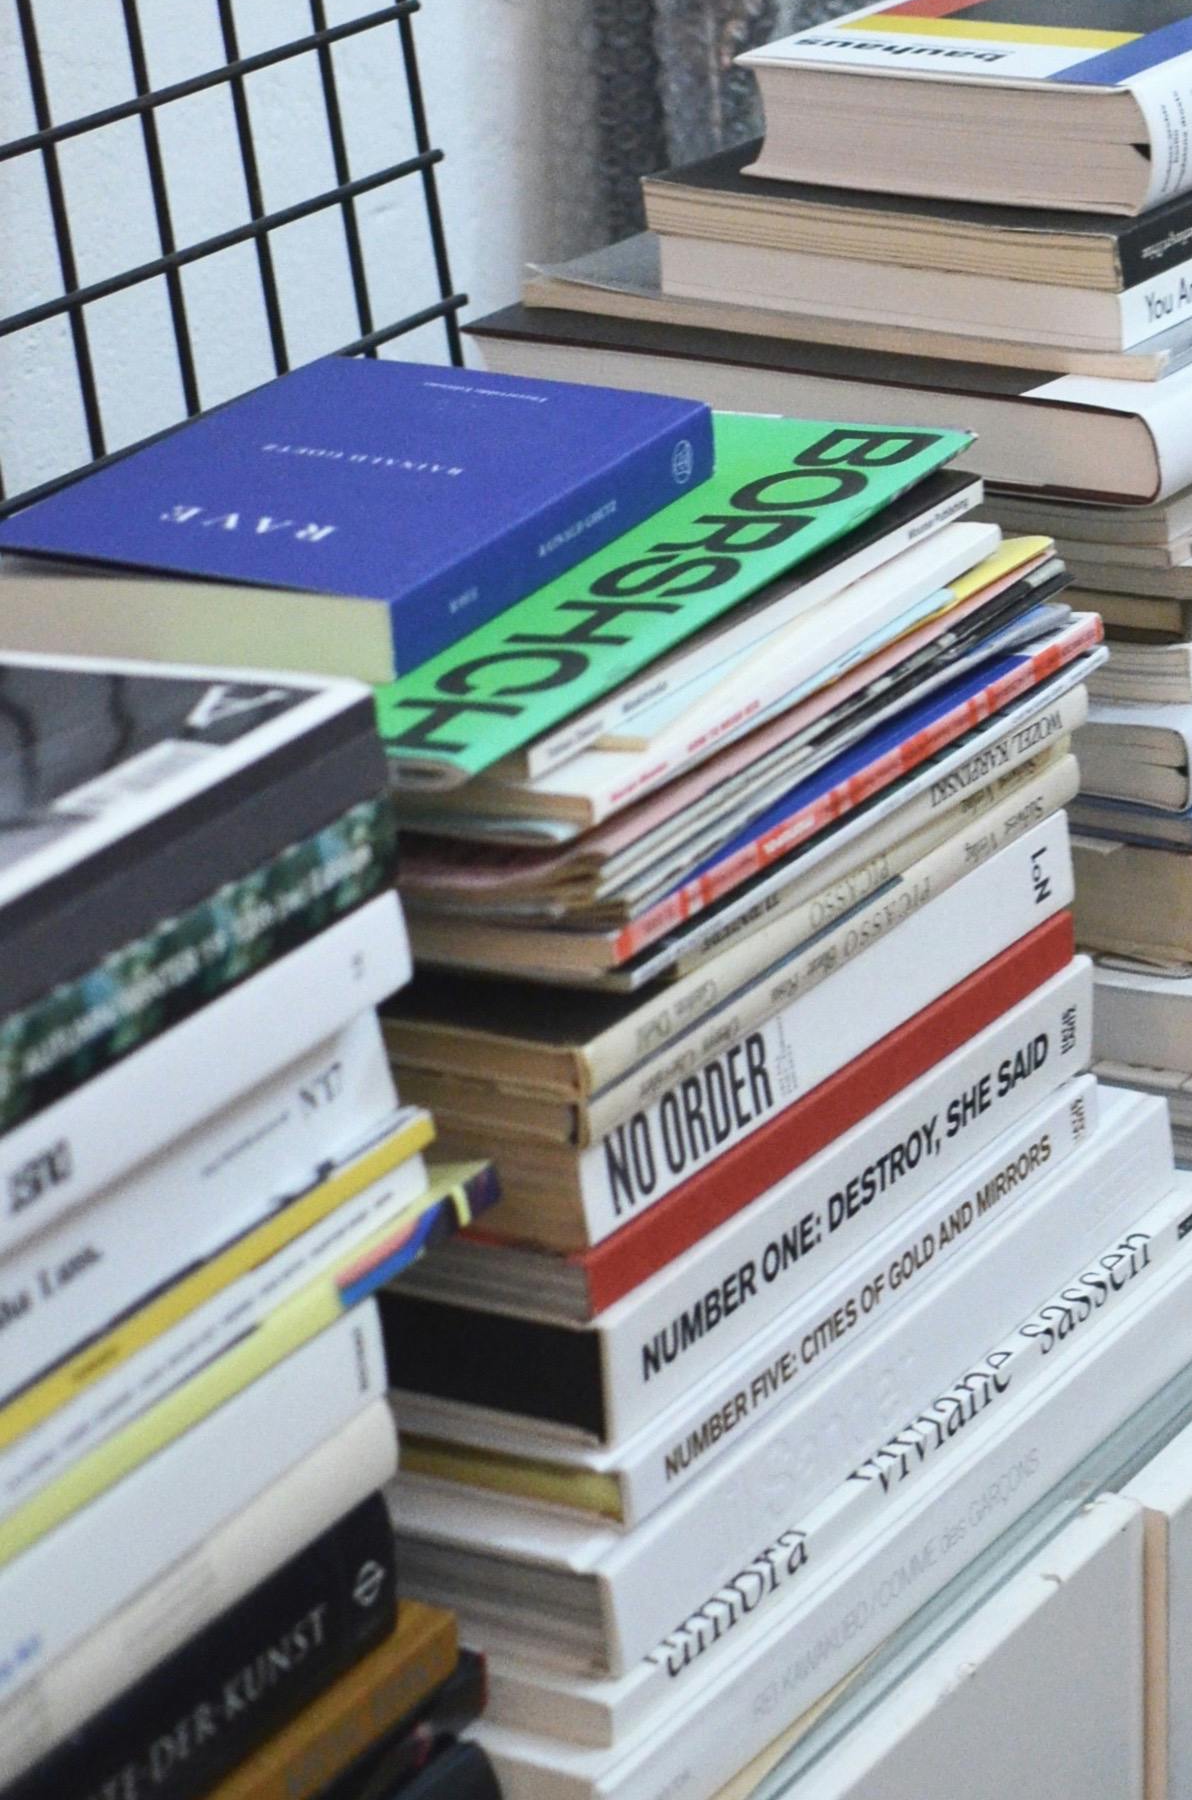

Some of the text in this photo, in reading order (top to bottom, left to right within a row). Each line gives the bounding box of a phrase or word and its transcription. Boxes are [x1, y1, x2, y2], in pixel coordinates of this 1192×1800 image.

[795, 37, 1008, 63] bauhaus
[1143, 290, 1174, 324] You
[160, 505, 339, 543] RAVE
[384, 428, 944, 752] BORSHCH
[842, 875, 931, 958] PICASSO
[602, 1111, 658, 1216] NO
[659, 1031, 774, 1175] ORDER
[641, 1260, 758, 1383] NUMBER
[760, 1209, 824, 1284] ONE:
[826, 1114, 942, 1234] DESTROY,
[945, 1075, 992, 1138] SHE
[996, 1032, 1051, 1098] SAID
[663, 1133, 1053, 1482] NUMBER FIVE: CITIES OF GOLD AND MIRRORS
[846, 1350, 1014, 1495] viviane
[222, 1602, 328, 1722] KUNST
